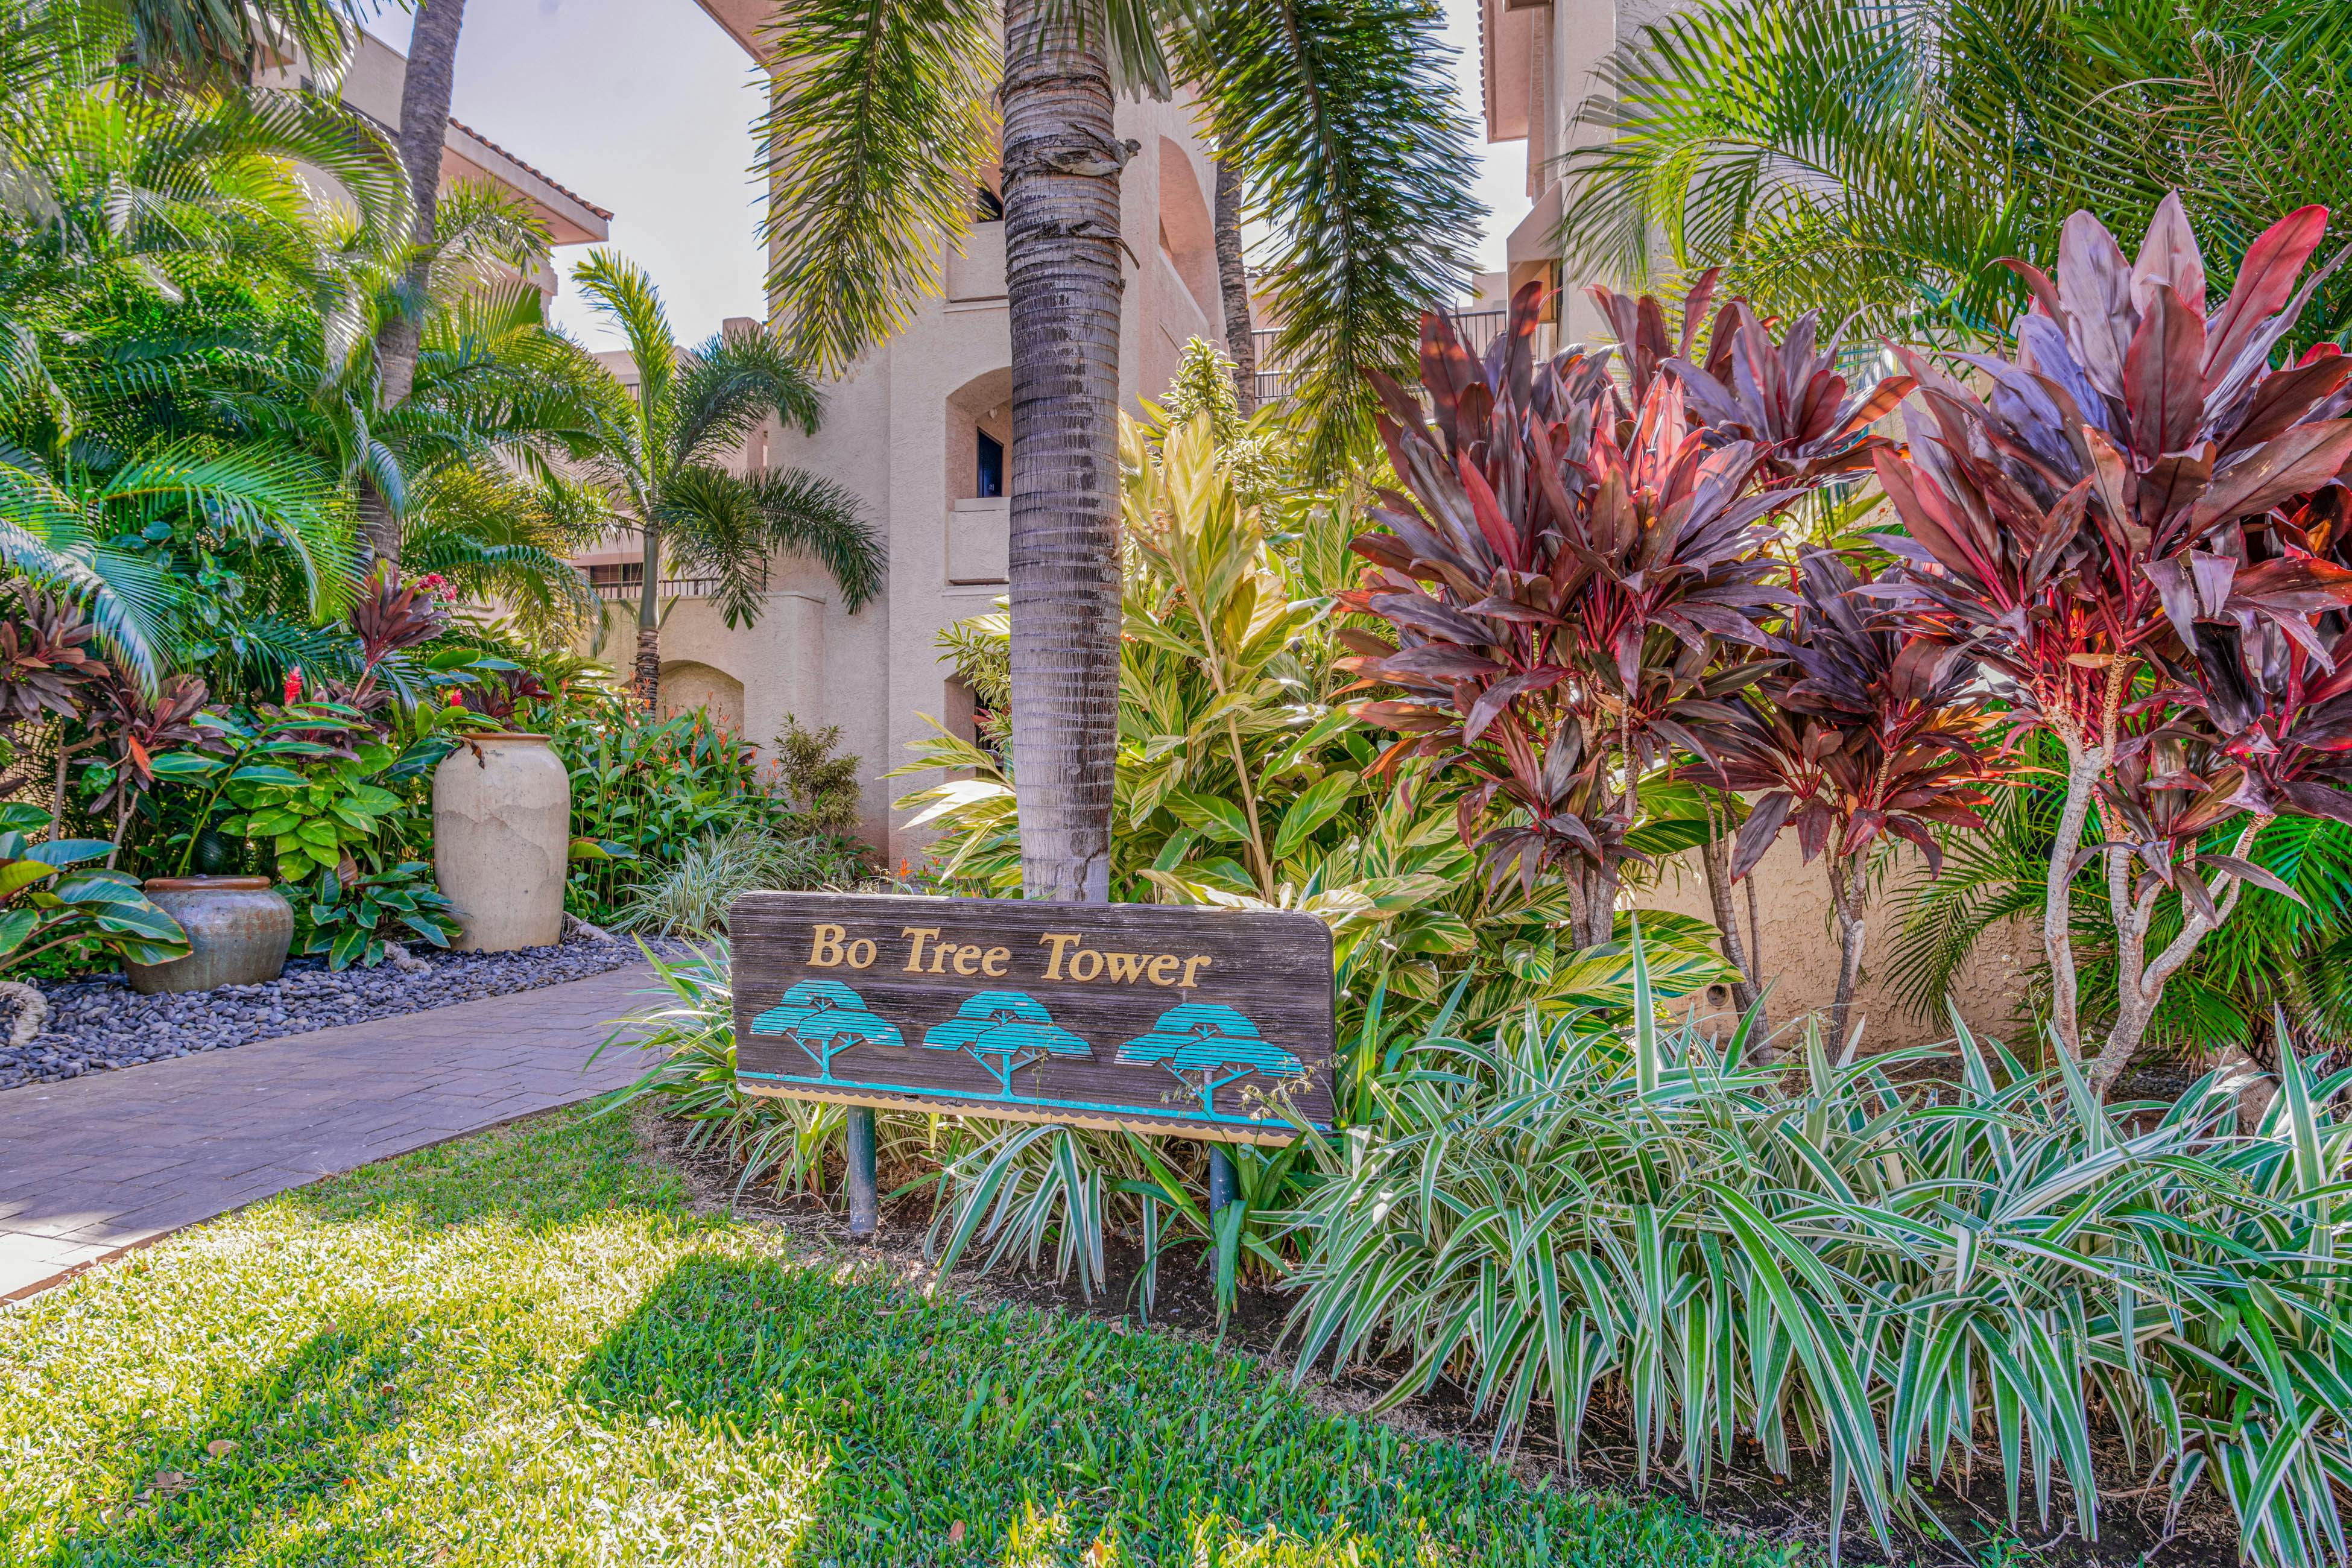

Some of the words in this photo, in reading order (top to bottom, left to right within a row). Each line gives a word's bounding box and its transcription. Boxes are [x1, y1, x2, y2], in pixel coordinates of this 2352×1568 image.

[806, 924, 877, 969] Bo
[901, 926, 1011, 977] Tree
[1039, 932, 1212, 988] Tower
